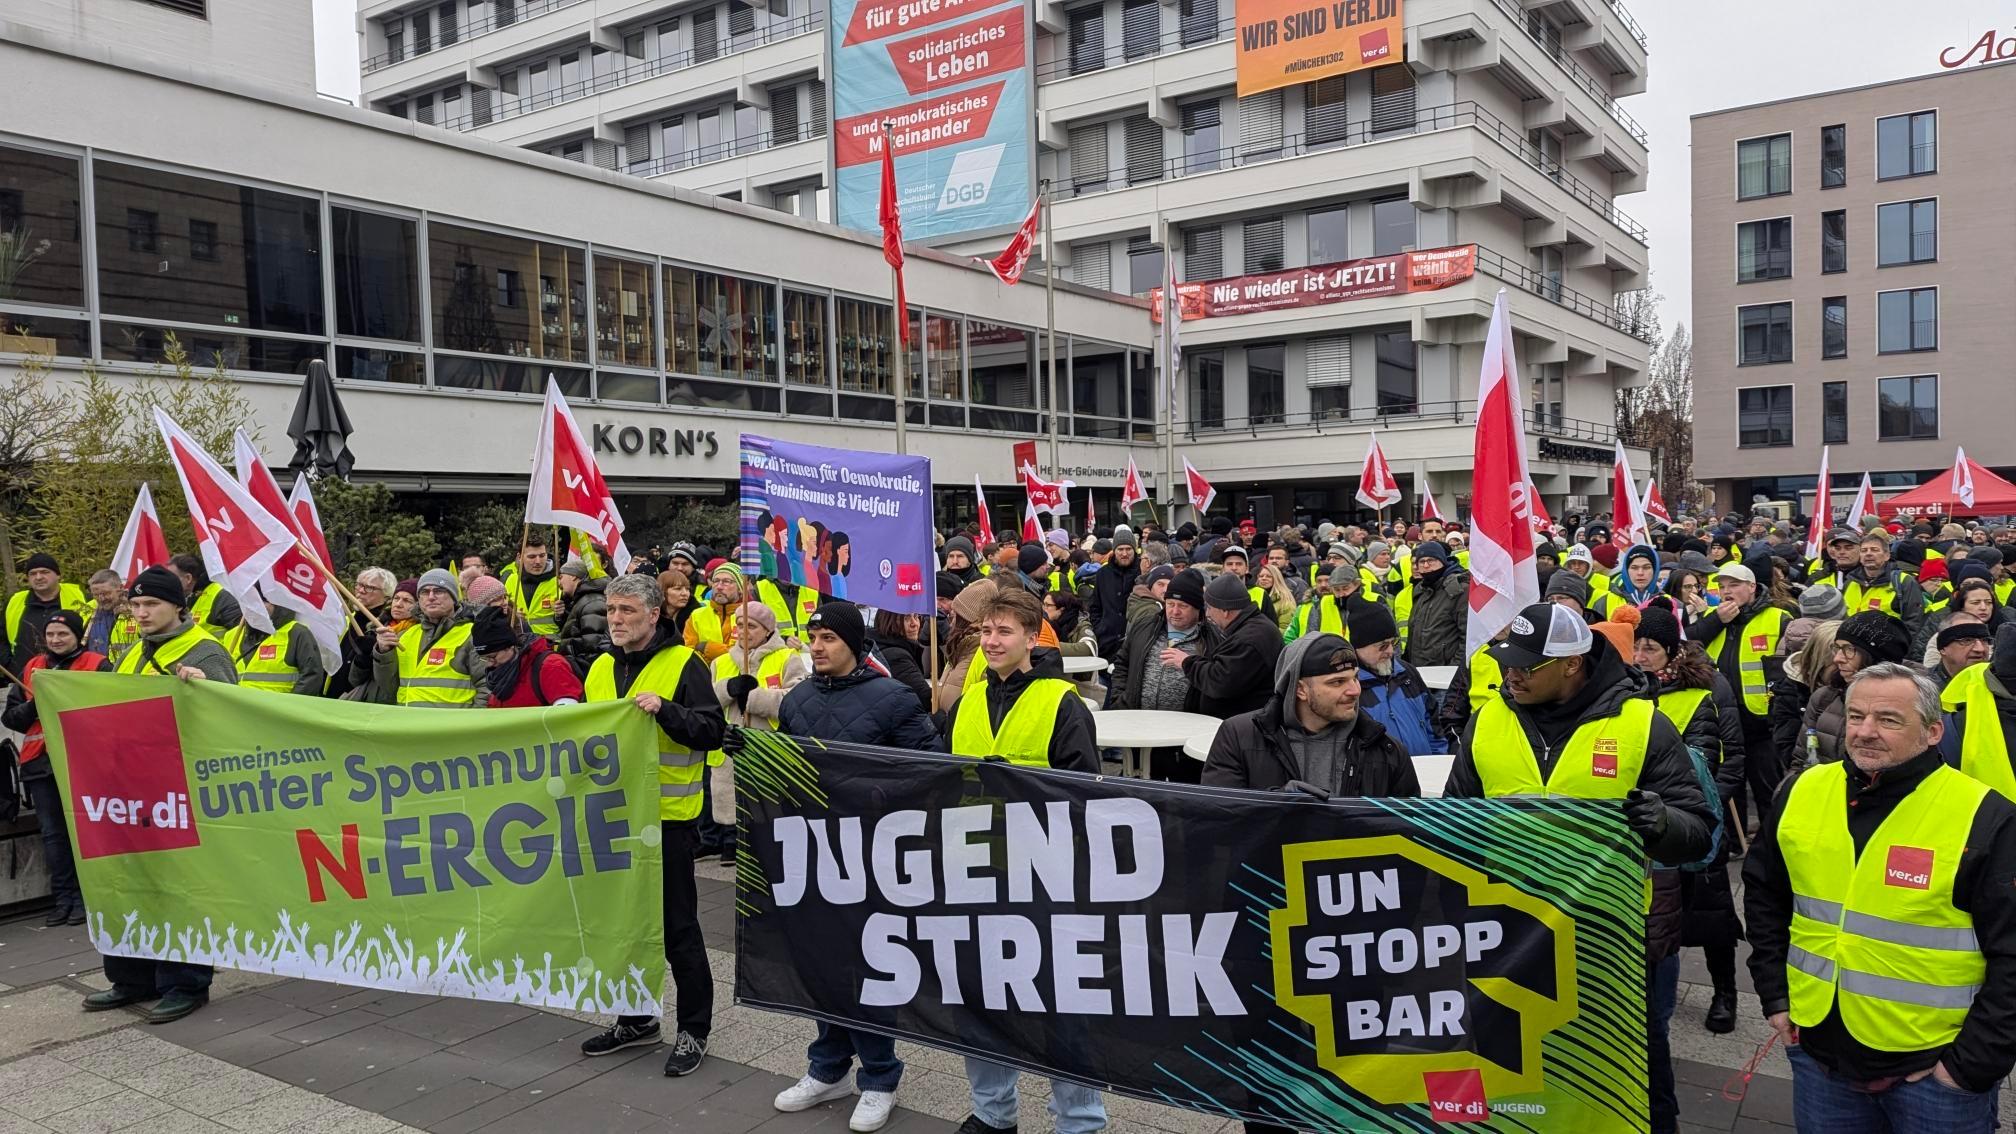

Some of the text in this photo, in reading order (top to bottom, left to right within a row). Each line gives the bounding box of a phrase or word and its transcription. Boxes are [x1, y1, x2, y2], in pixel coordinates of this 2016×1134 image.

[865, 0, 941, 29] für gute
[1242, 0, 1397, 52] WIR SIND VER.DI
[908, 24, 1006, 63] solidarisches
[1362, 46, 1388, 58] ver.di
[926, 50, 989, 82] Leben
[1284, 51, 1344, 74] #MÜNCHEN1302
[852, 118, 878, 136] und
[869, 118, 971, 154] Meinander
[946, 182, 984, 204] DGB
[1412, 261, 1450, 277] wählt
[1213, 286, 1239, 303] Nie
[1244, 277, 1298, 300] wieder
[1303, 271, 1326, 292] ist
[593, 424, 718, 457] KORN'S
[748, 453, 924, 496] ver.di Frauen für Demokratie,
[764, 478, 900, 518] Feminismus & Vielfalt!
[898, 582, 921, 591] ver.di
[194, 745, 326, 782] gemeinsam
[198, 733, 622, 820] unter Spannung
[1594, 766, 1616, 776] ver.di
[81, 792, 189, 829] ver.di
[771, 797, 1164, 908] JUGEND
[1316, 868, 1401, 917] UN
[1888, 868, 1928, 886] ver.di
[860, 911, 1249, 1017] STREIK
[1304, 920, 1504, 980] STOPP
[1346, 990, 1466, 1041] BAR
[1432, 1100, 1547, 1116] ver.di JUGEND
